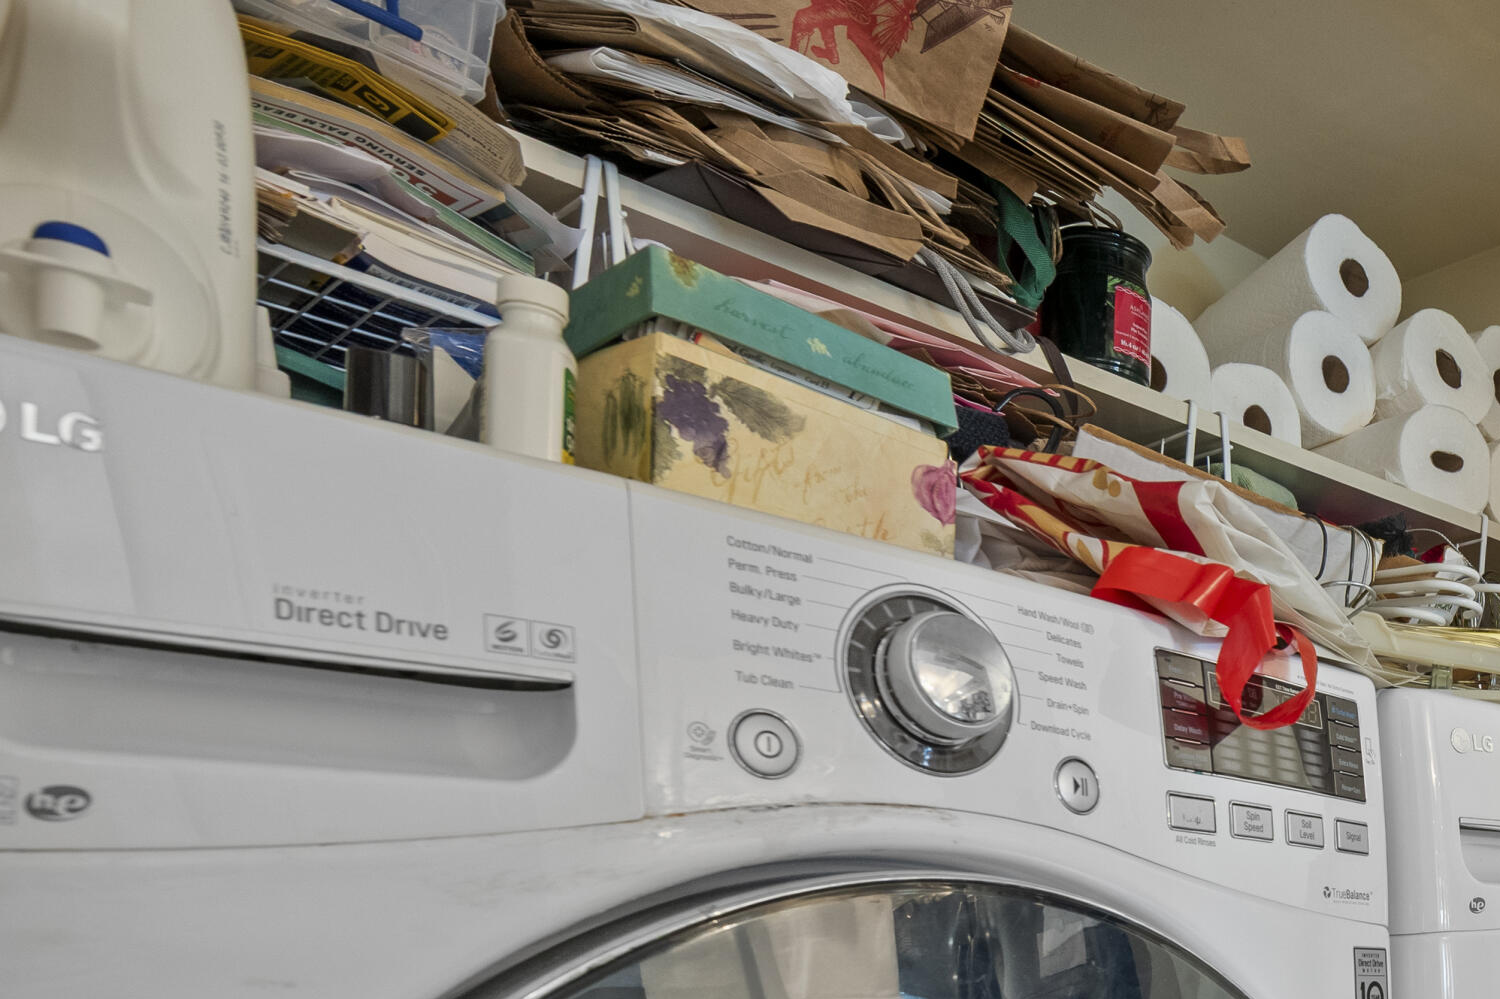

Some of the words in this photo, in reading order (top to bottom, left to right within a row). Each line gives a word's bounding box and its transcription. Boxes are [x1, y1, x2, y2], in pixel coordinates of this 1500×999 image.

[302, 116, 352, 141] PALM
[355, 133, 427, 177] SERVING
[21, 401, 103, 452] LG
[726, 535, 813, 563] Cotton/Normal
[728, 558, 762, 574] Perm.
[765, 566, 798, 582] Press
[729, 581, 802, 606] Bulky/Large
[274, 598, 366, 631] Direct
[375, 611, 449, 640] Drive
[731, 609, 769, 627] Heavy
[771, 616, 800, 632] Duty
[1017, 605, 1037, 619] Hand
[1038, 610, 1080, 630] Wash/Wool
[732, 639, 770, 656] Bright
[1046, 631, 1082, 649] Delicates
[1056, 653, 1084, 669] Towels
[735, 670, 758, 684] Tub
[760, 674, 795, 690] Clean
[1038, 671, 1064, 686] Speed
[1064, 678, 1088, 691] Wash
[1046, 698, 1090, 716] Drain+Spin
[1030, 720, 1070, 737] Download
[1070, 729, 1092, 742] Cycle
[1472, 734, 1494, 753] LG
[1246, 810, 1260, 822] Spin
[1301, 819, 1312, 829] Soil
[1243, 822, 1264, 834] Speed
[1299, 830, 1315, 841] Level
[1346, 832, 1362, 843] Signal
[1184, 836, 1197, 845] Cold
[1197, 838, 1217, 847] Rinses
[1358, 959, 1372, 968] Direct
[1372, 959, 1384, 968] Drive
